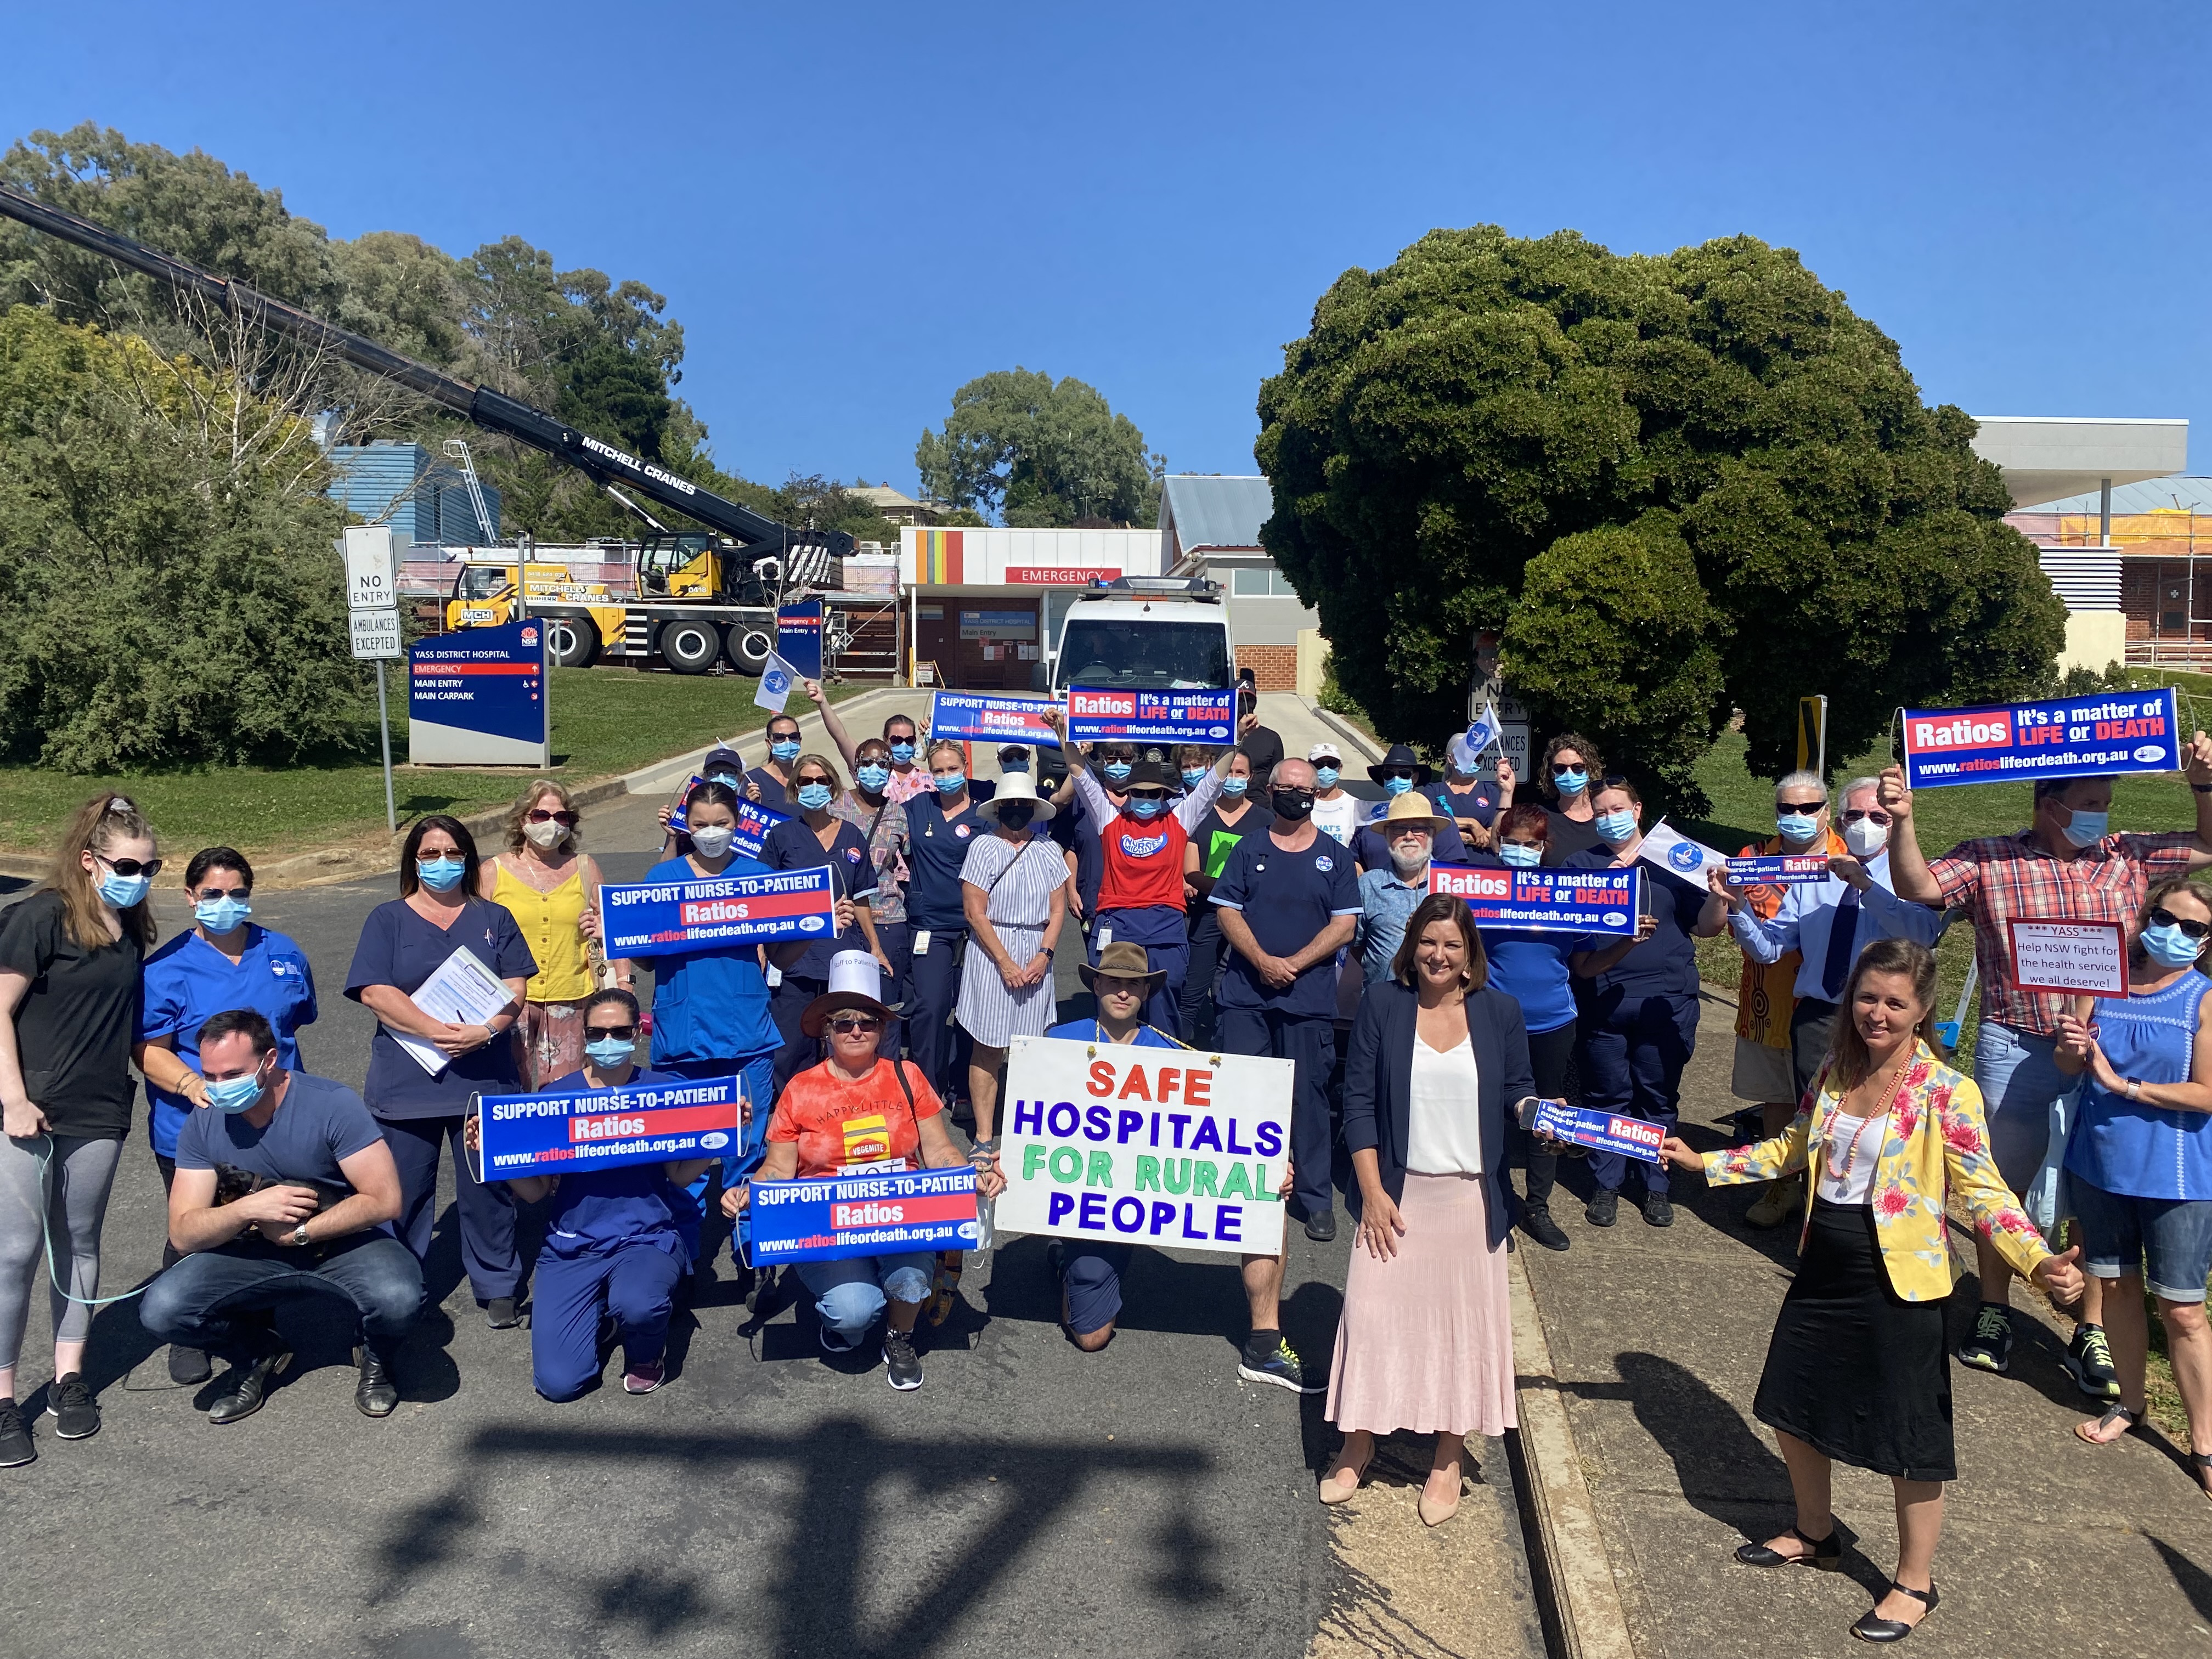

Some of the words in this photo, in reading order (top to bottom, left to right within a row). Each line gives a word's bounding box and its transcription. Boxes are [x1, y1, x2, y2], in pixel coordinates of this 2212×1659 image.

[582, 436, 641, 472] MITCHELL
[644, 465, 696, 495] CRANES
[360, 575, 381, 588] NO
[1022, 570, 1104, 582] EMERGENCY
[353, 591, 390, 602] ENTRY
[529, 584, 582, 593] MITCHELL
[565, 594, 609, 602] CRANES
[353, 618, 395, 632] AMBULANCES
[979, 629, 996, 637] Entry
[356, 636, 395, 650] EXCEPTED
[414, 664, 462, 673] EMERGENCY
[438, 679, 463, 687] ENTRY
[438, 692, 474, 700] CARPARK
[940, 697, 984, 709] SUPPORT
[1075, 696, 1132, 714] Ratios
[1139, 693, 1159, 706] It's
[1162, 696, 1170, 706] a
[1173, 695, 1214, 707] matter
[1217, 695, 1230, 707] of
[984, 712, 1025, 726] Ratios
[1139, 706, 1167, 719] LIFE
[1171, 708, 1184, 718] or
[1187, 707, 1229, 720] DEATH
[2017, 708, 2049, 726] It's
[2053, 711, 2067, 723] a
[2071, 703, 2137, 722] matter
[2143, 699, 2163, 716] of
[1075, 724, 1206, 736] www.ratioslifeordeath.org.au
[1915, 720, 2007, 747] Ratios
[2019, 726, 2064, 746] LIFE
[2069, 727, 2090, 740] or
[2096, 717, 2165, 741] DEATH
[1919, 749, 2129, 776] www.ratioslifeordeath.org.au
[738, 818, 763, 837] IFE
[759, 814, 769, 824] a
[1785, 859, 1826, 871] Ratios
[1437, 873, 1508, 896] Ratios
[1517, 871, 1541, 886] It's
[1545, 874, 1554, 886] a
[1558, 873, 1609, 888] matter
[1613, 874, 1629, 889] of
[611, 886, 680, 906] SUPPORT
[684, 874, 822, 900] NURSE-TO-PATIENT
[1517, 887, 1550, 902] LIFE
[1555, 888, 1571, 901] or
[1576, 888, 1629, 905] DEATH
[685, 902, 749, 924] Ratios
[614, 919, 795, 947] www.ratioslifeordeath.org.au
[2051, 926, 2080, 936] YASS
[2018, 943, 2041, 954] Help
[2045, 944, 2070, 953] NSW
[2074, 945, 2099, 956] fight
[2102, 946, 2118, 956] for
[834, 959, 844, 968] Staff
[854, 958, 872, 967] Patient
[2021, 958, 2039, 968] the
[2041, 958, 2075, 969] health
[2079, 962, 2117, 972] service
[2048, 975, 2060, 985] all
[2063, 976, 2110, 988] deserve!
[1086, 1060, 1212, 1107] SAFE
[492, 1099, 571, 1120] SUPPORT
[574, 1086, 728, 1114] NURSE-TO-PATIENT
[1547, 1106, 1578, 1118] support
[816, 1105, 855, 1125] HAPPY
[862, 1100, 903, 1111] LITTLE
[1541, 1110, 1605, 1133] nurse-to-patient
[574, 1116, 645, 1139] Ratios
[1013, 1099, 1283, 1158] HOSPITALS
[1610, 1119, 1660, 1146] Ratios
[493, 1137, 696, 1166] www.ratioslifeordeath.org.au
[853, 1143, 884, 1155] VEGEMITE
[1022, 1144, 1113, 1188] FOR
[1135, 1154, 1282, 1202] RURAL
[758, 1185, 833, 1206] SUPPORT
[836, 1203, 904, 1227] Ratios
[1048, 1192, 1243, 1242] PEOPLE
[759, 1226, 953, 1252] www.ratioslifeordeath.org.au
